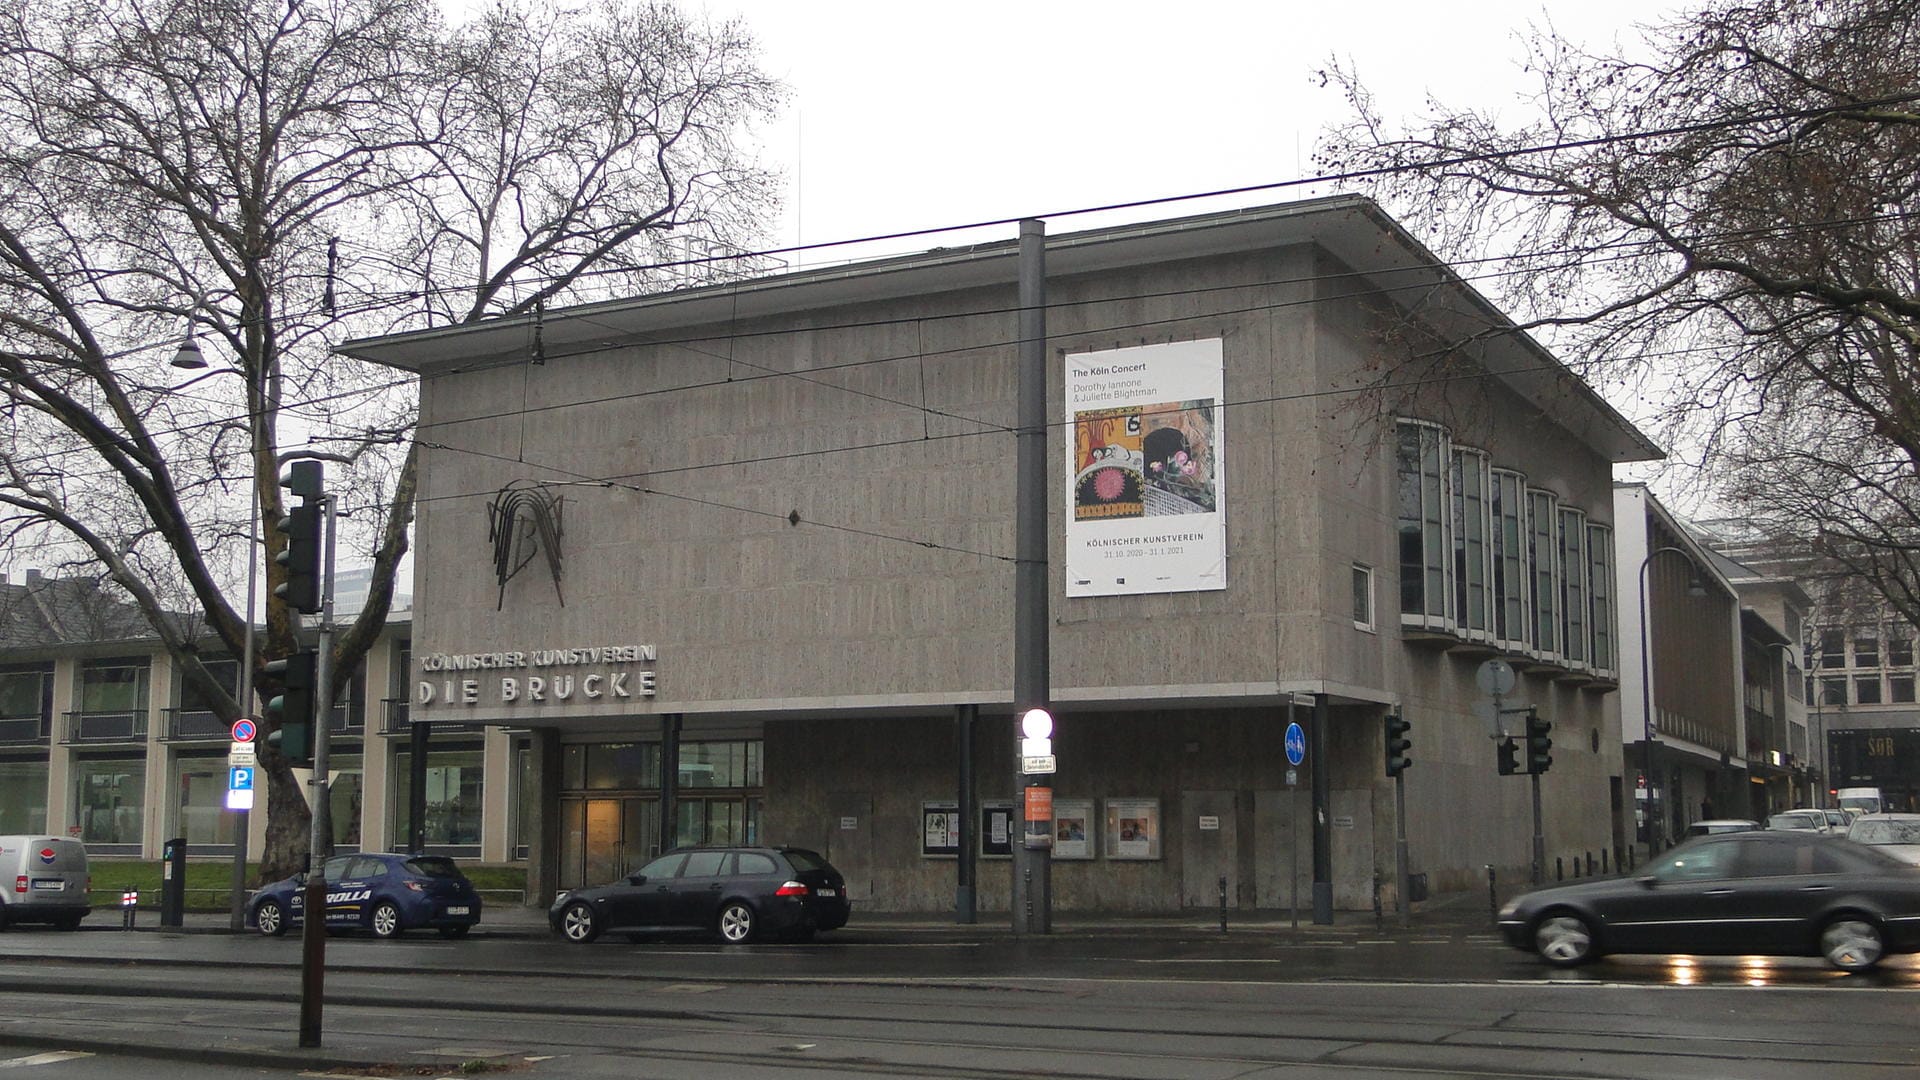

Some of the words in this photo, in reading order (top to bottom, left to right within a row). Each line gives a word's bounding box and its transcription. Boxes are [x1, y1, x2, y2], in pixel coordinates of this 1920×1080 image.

[1073, 369, 1088, 378] The
[1090, 366, 1109, 376] Köln
[1111, 363, 1146, 374] Concert
[1073, 382, 1106, 393] Dorothy
[1108, 379, 1142, 389] Iannone
[1073, 394, 1079, 402] &
[1081, 391, 1112, 402] Juliette
[1114, 388, 1157, 399] Blightman
[1086, 537, 1140, 548] KÖLNISCHER
[1143, 533, 1204, 544] KUNSTVEREIN
[420, 651, 528, 672] KÖLNISCHER
[531, 643, 657, 666] KUNSTVEREIN
[419, 679, 479, 705] DIE
[502, 671, 656, 702] BRÜCKE
[234, 770, 249, 788] P
[326, 890, 371, 903] ROLLA
